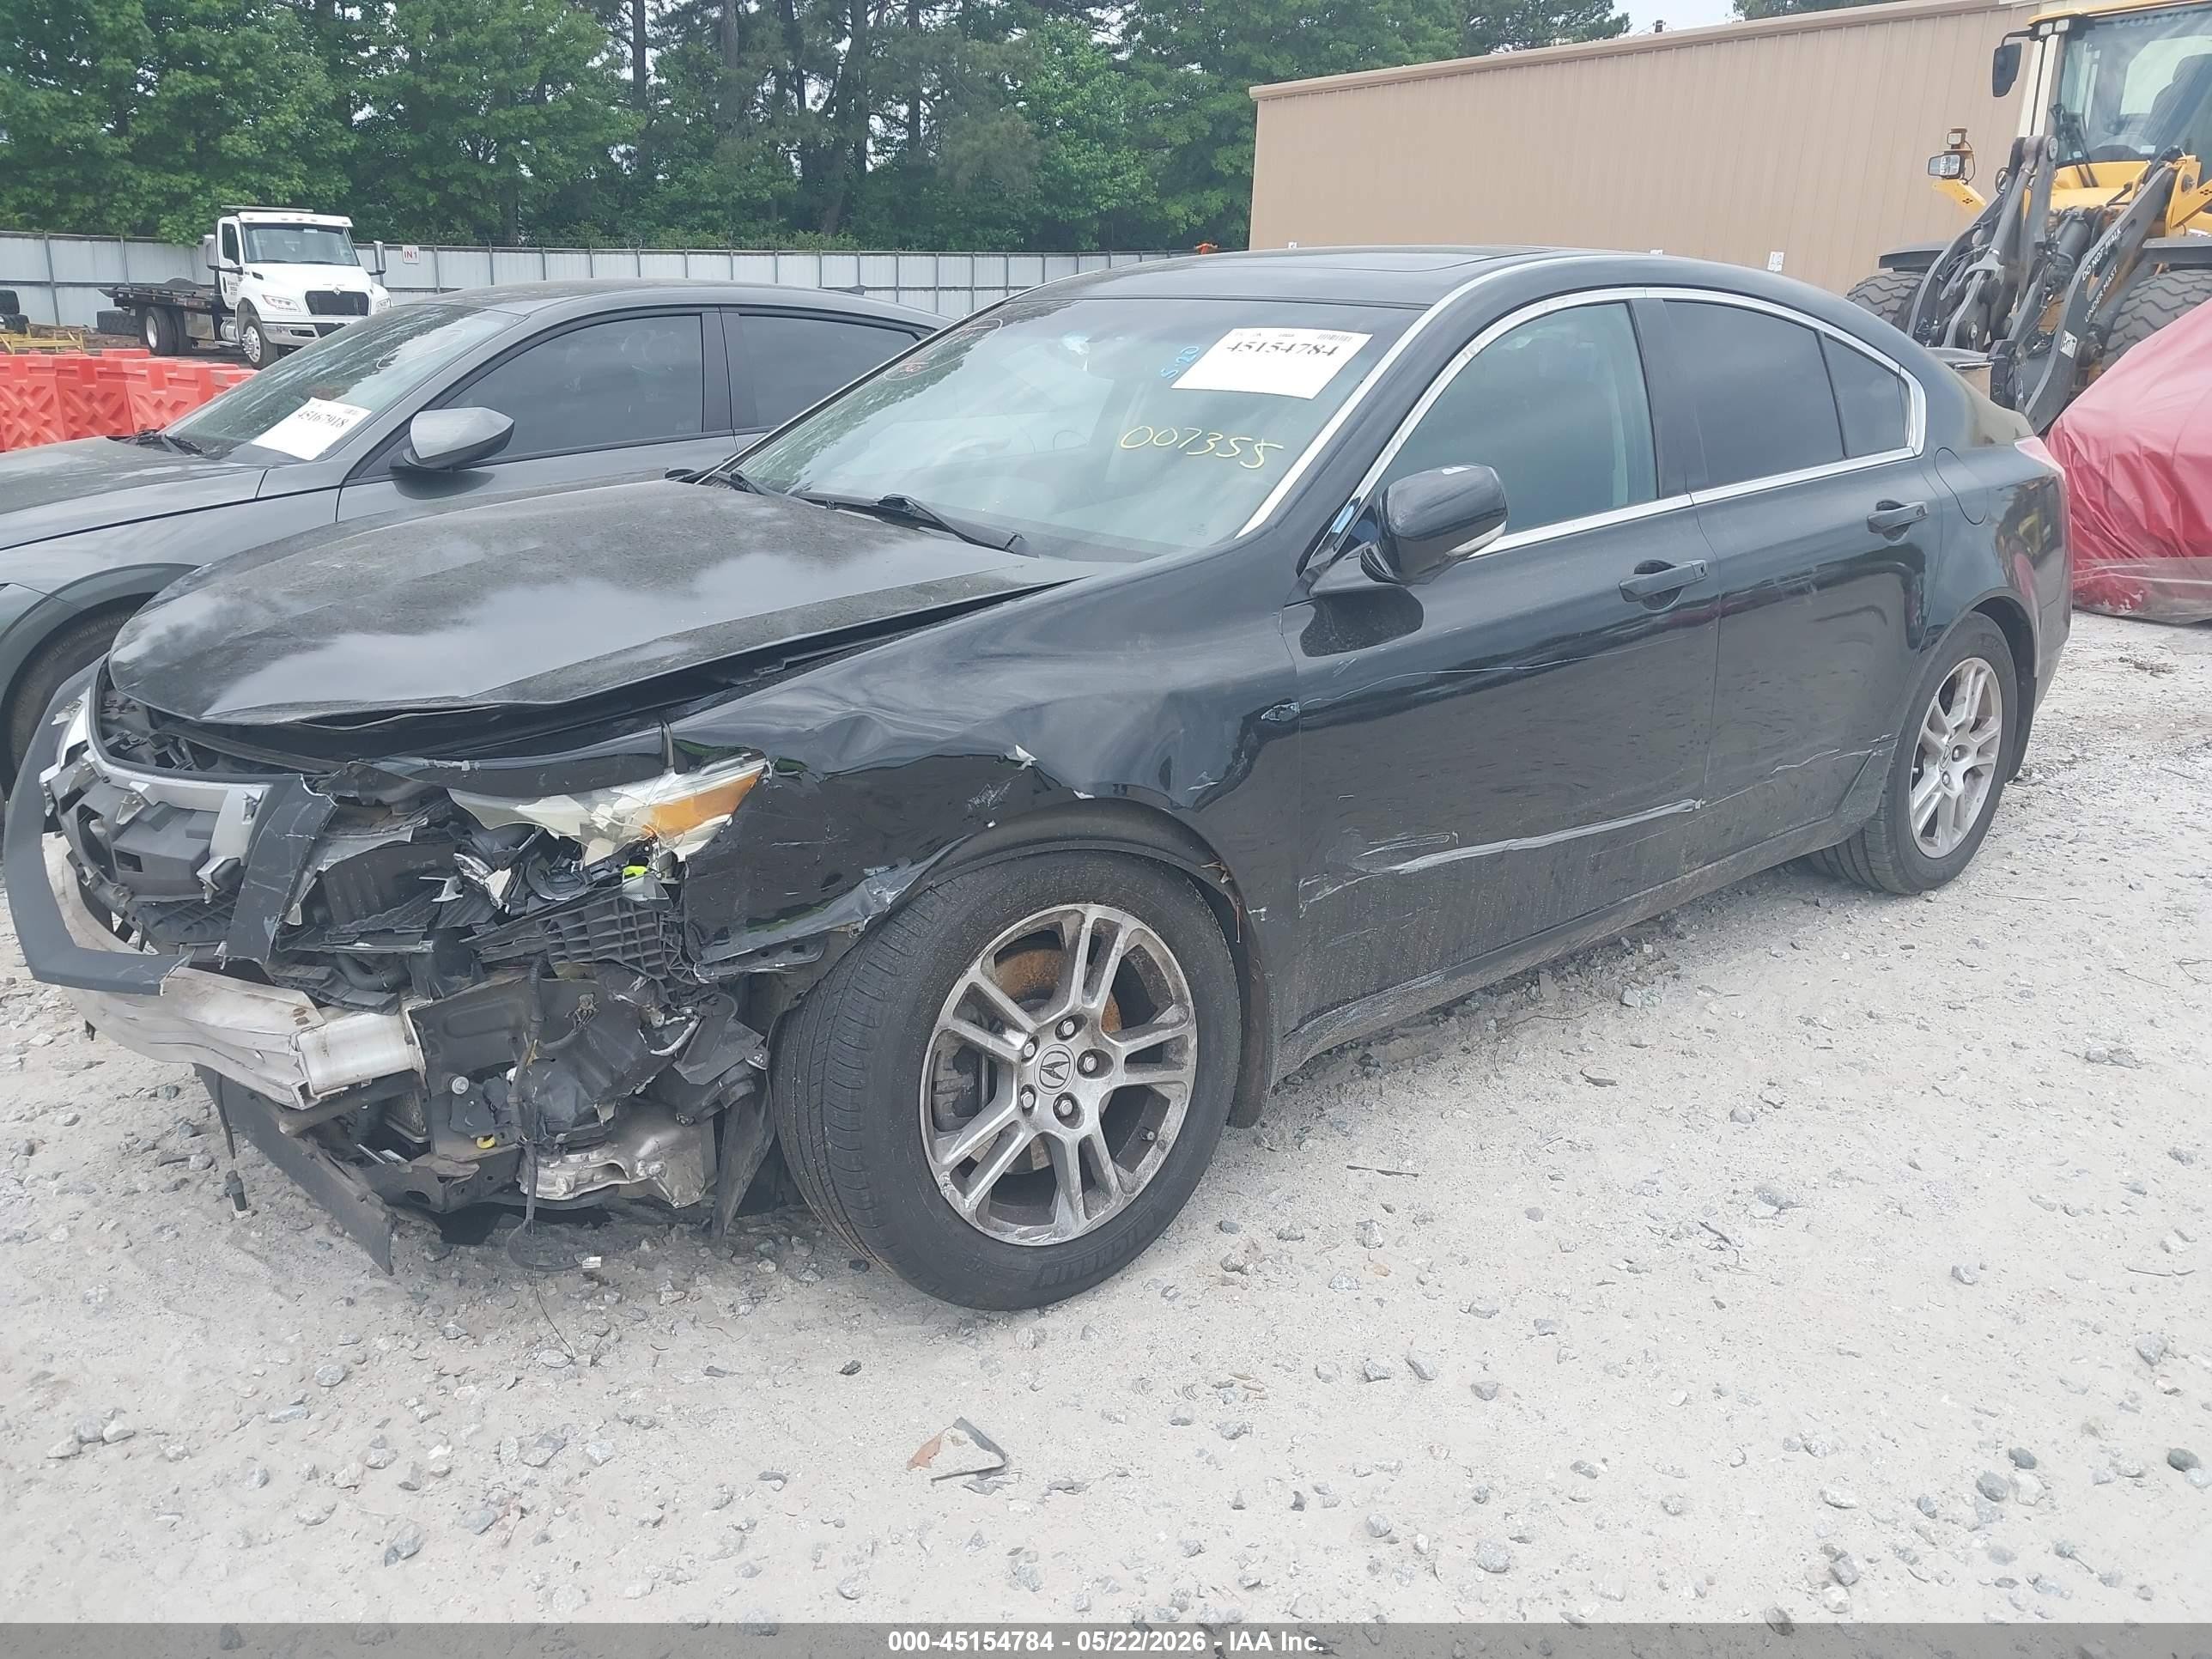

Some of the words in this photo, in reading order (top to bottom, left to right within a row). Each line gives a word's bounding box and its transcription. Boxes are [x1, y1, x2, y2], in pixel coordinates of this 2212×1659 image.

[2081, 264, 2091, 281] DO
[2092, 247, 2105, 267] NOT
[2105, 227, 2122, 250] WALK
[2084, 291, 2104, 323] UNDER
[2103, 264, 2118, 291] MAST
[1226, 341, 1340, 356] 45154784
